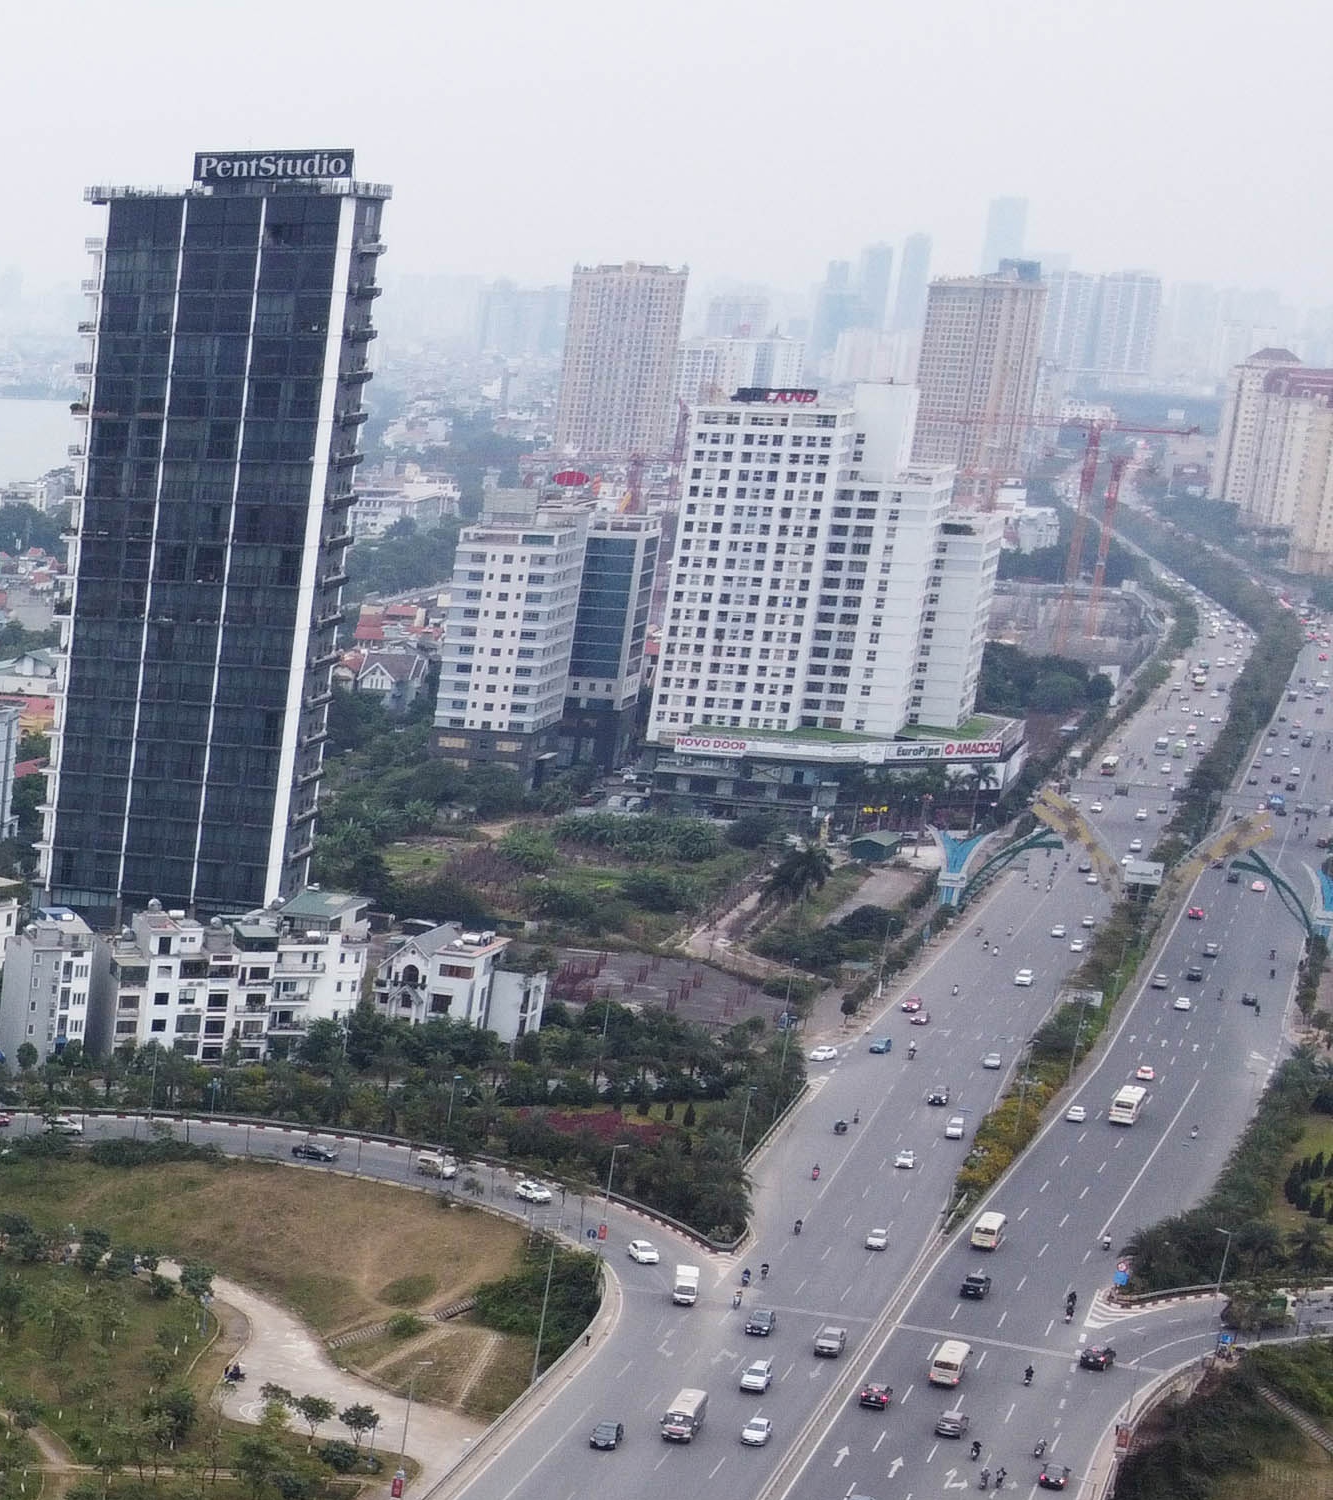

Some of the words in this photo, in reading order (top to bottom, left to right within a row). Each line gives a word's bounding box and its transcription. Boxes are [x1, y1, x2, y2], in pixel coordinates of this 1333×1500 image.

[200, 153, 346, 178] PentStudio
[676, 737, 710, 748] NOVO
[713, 740, 746, 751] DOOR
